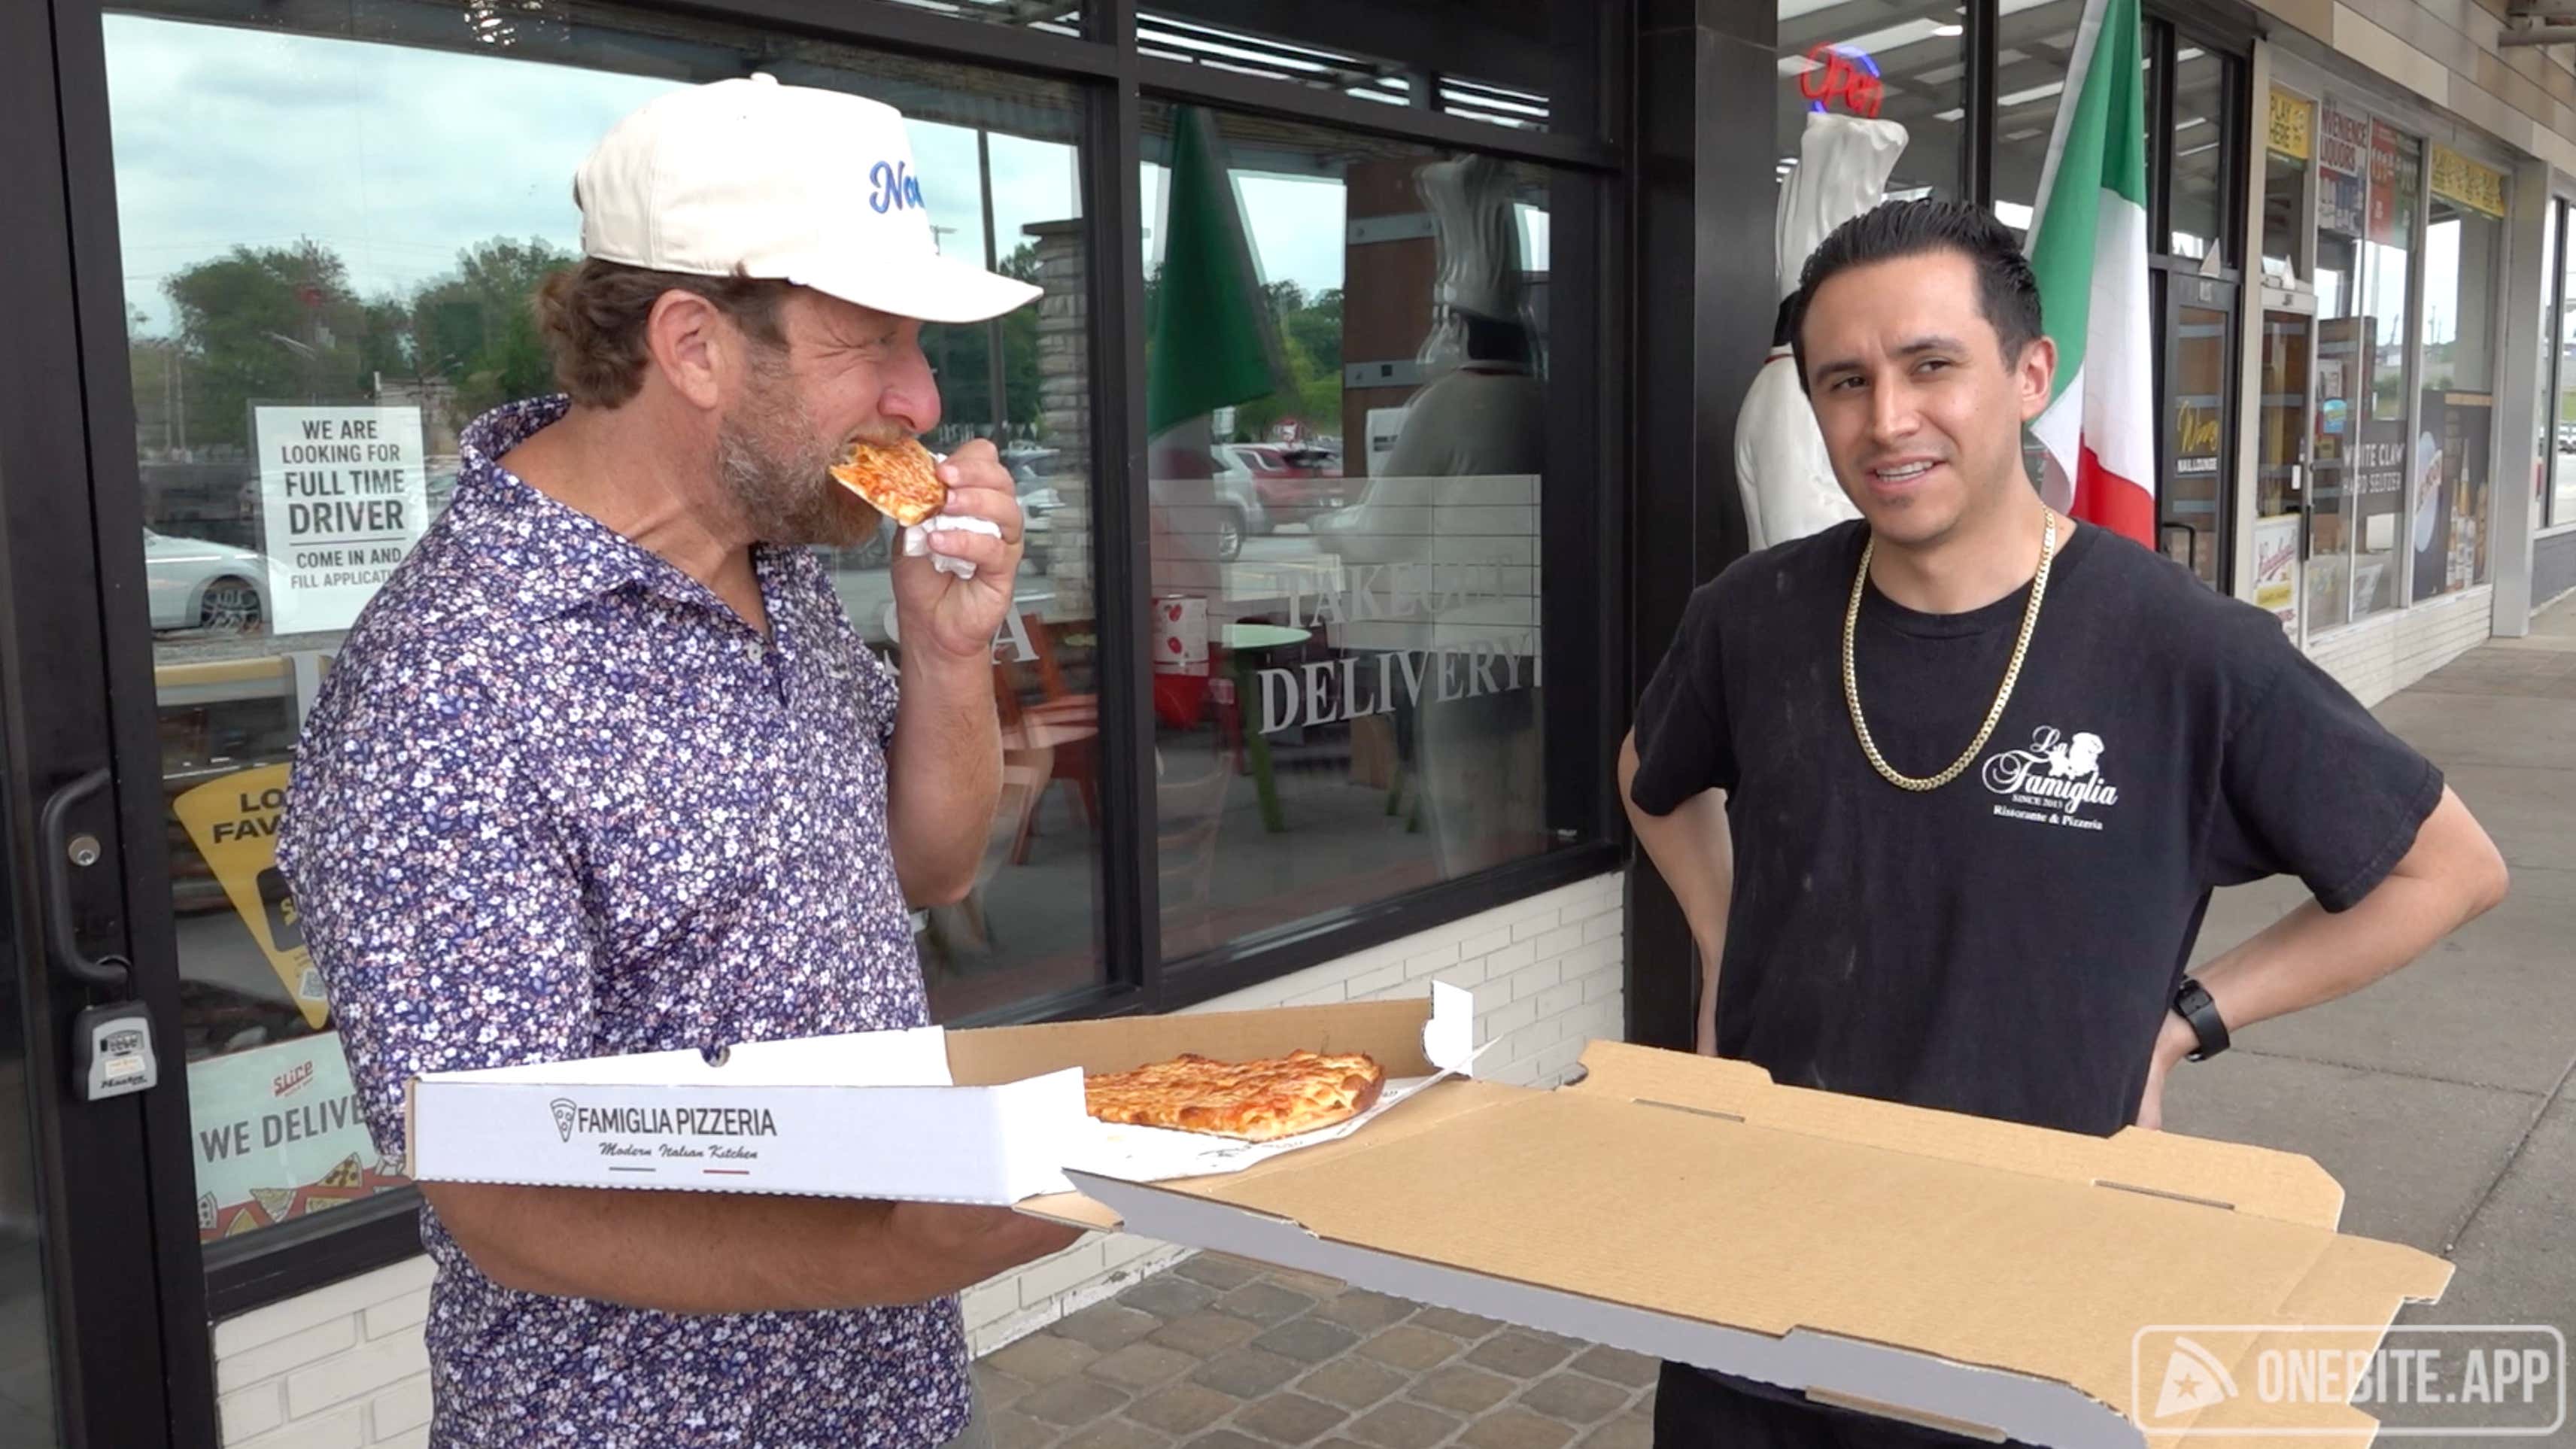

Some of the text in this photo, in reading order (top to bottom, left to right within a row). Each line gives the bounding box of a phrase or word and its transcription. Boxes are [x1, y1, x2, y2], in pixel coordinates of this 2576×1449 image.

[302, 420, 378, 440] WE ARE
[281, 444, 400, 464] LOOKING FOR
[284, 469, 406, 497] FULL TIME
[288, 500, 405, 535] DRIVER
[296, 547, 402, 569] COME IN AND
[290, 572, 318, 589] FILL
[1258, 633, 1530, 735] DELIVERY
[2030, 724, 2068, 754] La
[1982, 749, 2119, 814] Famiglia
[2011, 794, 2041, 807] SINCE
[1994, 804, 2104, 830] Ristorante & Pizzeria
[578, 1107, 778, 1136] FAMIGLIA PIZZERIA
[200, 1121, 250, 1163] WE
[598, 1141, 758, 1159] Modern Italian Kitchen
